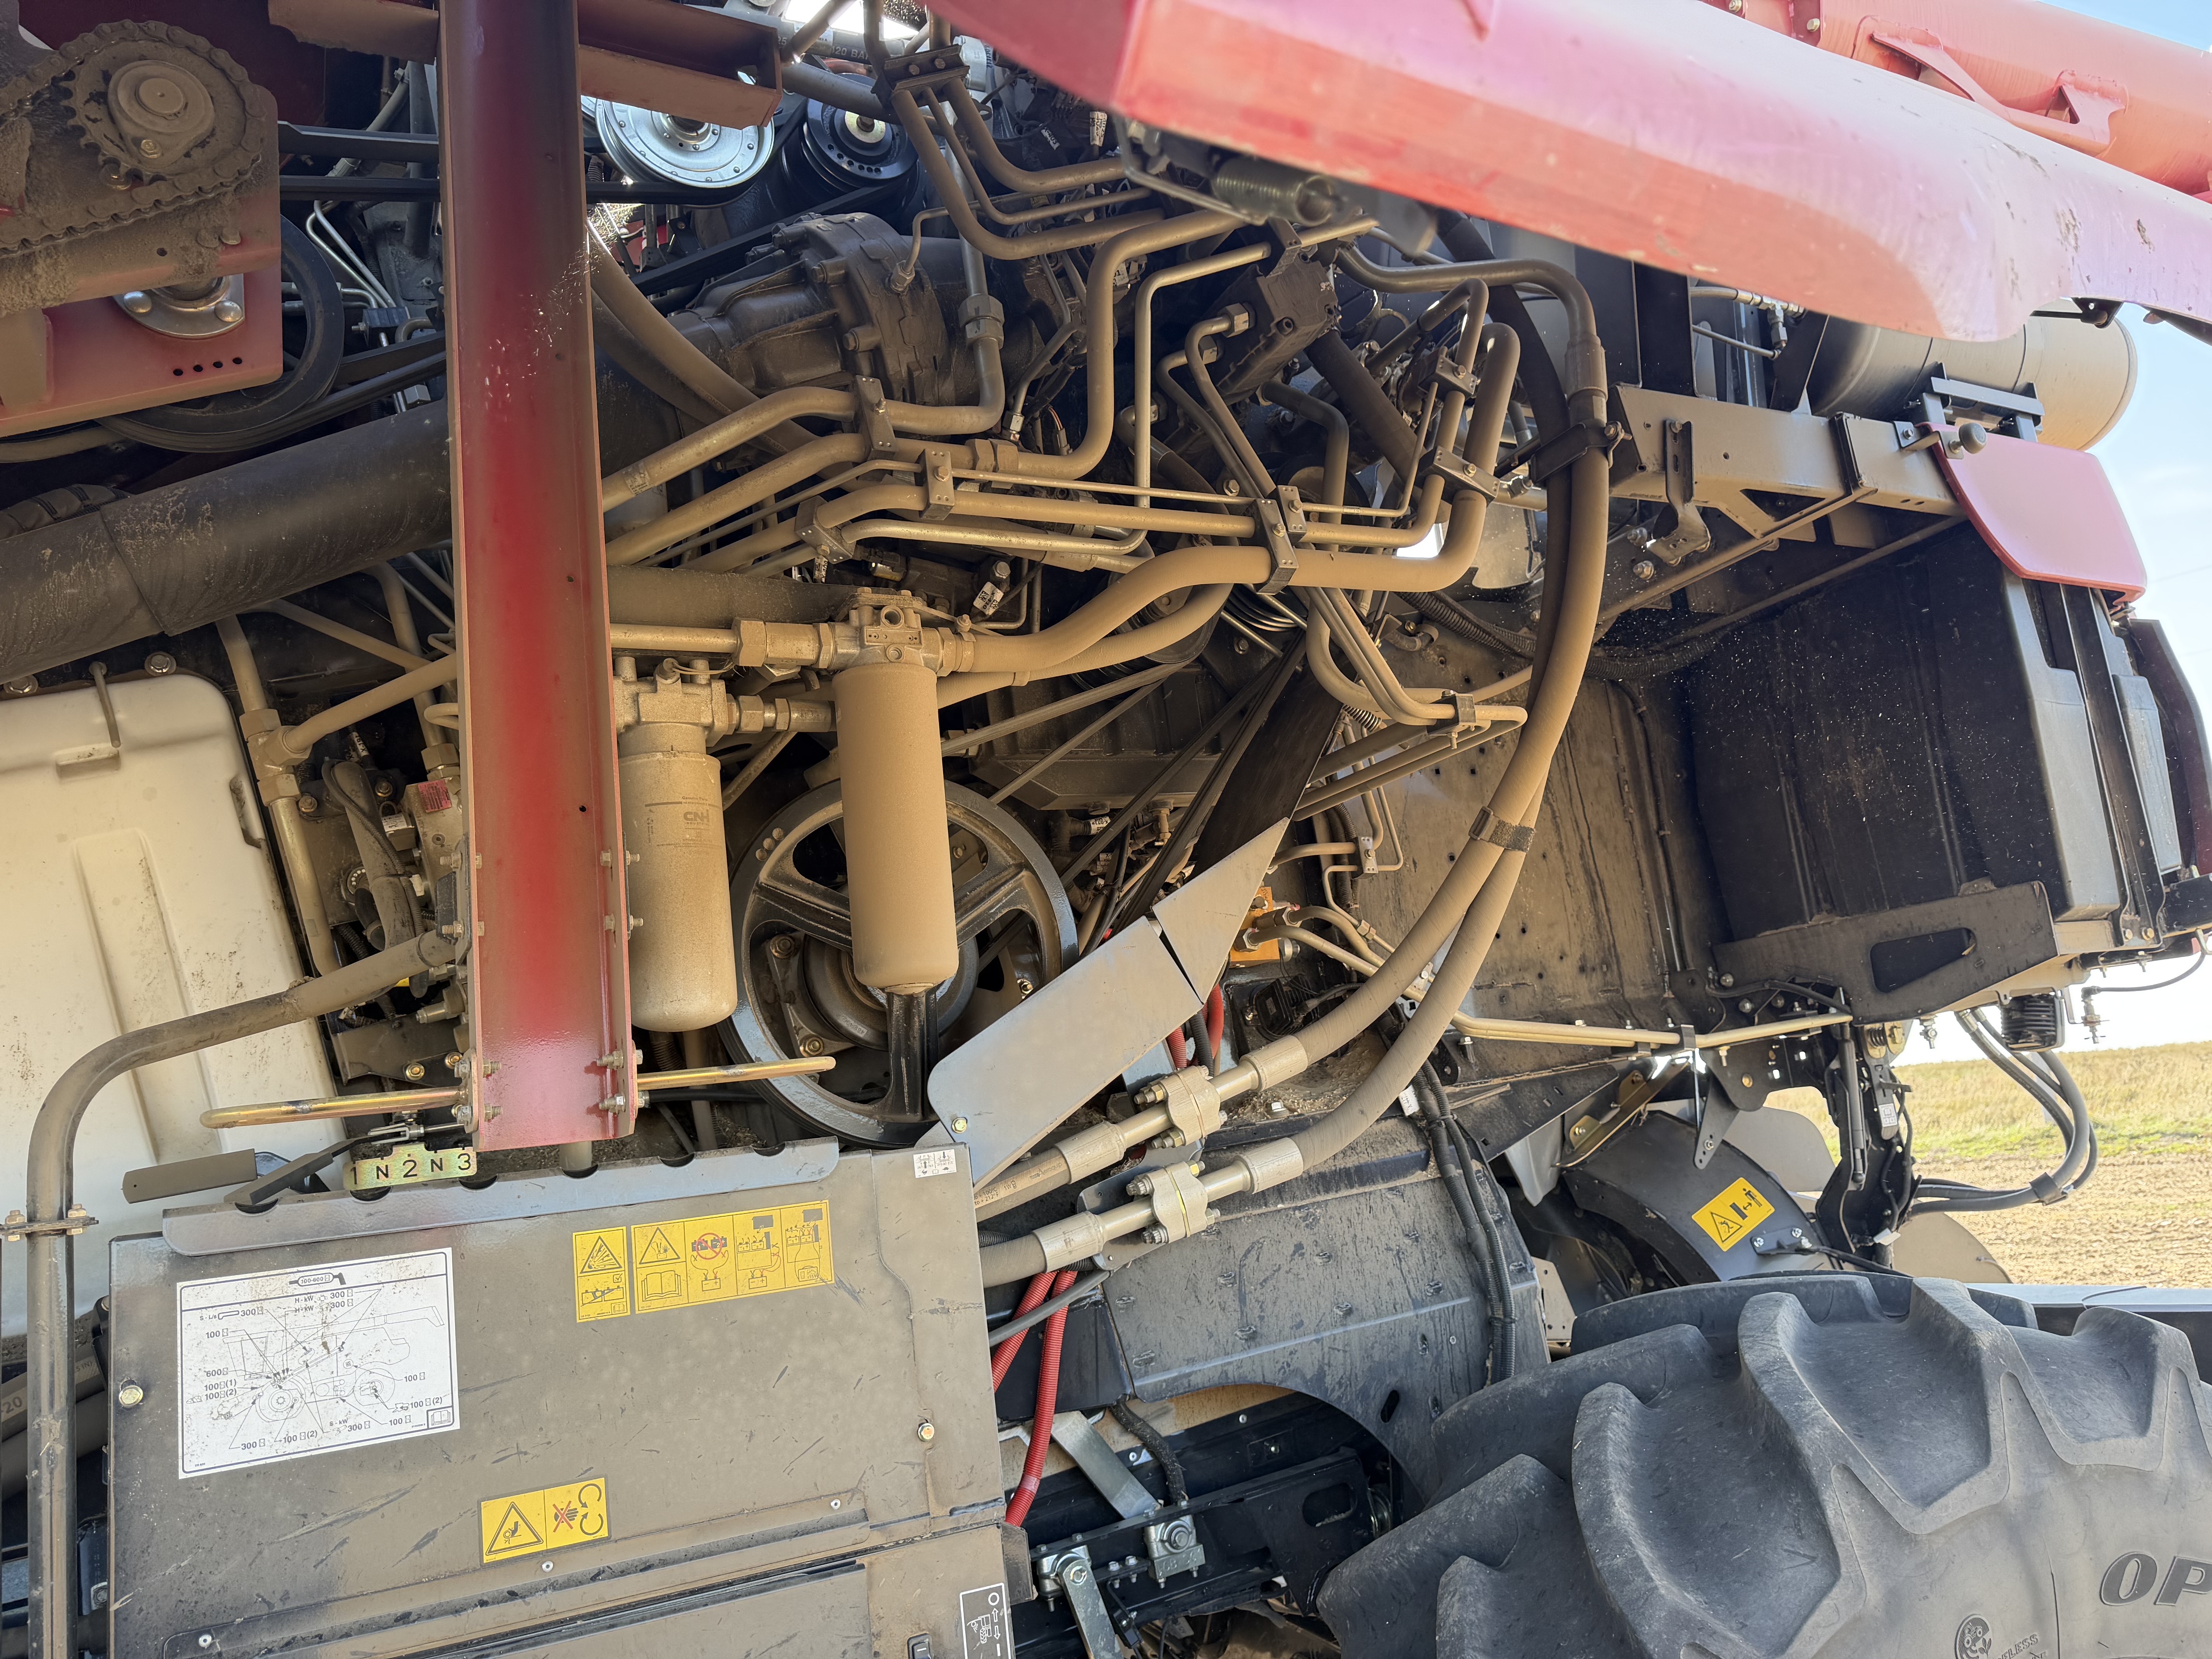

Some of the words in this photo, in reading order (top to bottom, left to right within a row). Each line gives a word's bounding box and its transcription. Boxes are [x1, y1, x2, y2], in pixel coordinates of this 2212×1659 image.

[683, 809, 709, 823] CNH
[376, 1164, 389, 1180] N
[403, 1159, 417, 1178] 2
[431, 1158, 443, 1172] N
[458, 1153, 471, 1171] 3
[330, 1300, 345, 1309] 300
[240, 1308, 256, 1317] 300
[206, 1330, 220, 1339] 100
[206, 1369, 222, 1377] 600
[404, 1374, 417, 1382] 100
[204, 1382, 219, 1391] 100
[226, 1378, 237, 1388] (1)
[205, 1392, 219, 1400] 100
[226, 1388, 237, 1398] (2)
[410, 1400, 423, 1408] 100
[433, 1396, 442, 1406] (2)
[389, 1418, 403, 1426] 100
[348, 1423, 362, 1432] 300
[283, 1435, 297, 1444] 100
[307, 1430, 318, 1439] (2)
[241, 1441, 257, 1450] 300
[1998, 1633, 2038, 1659] ELESS
